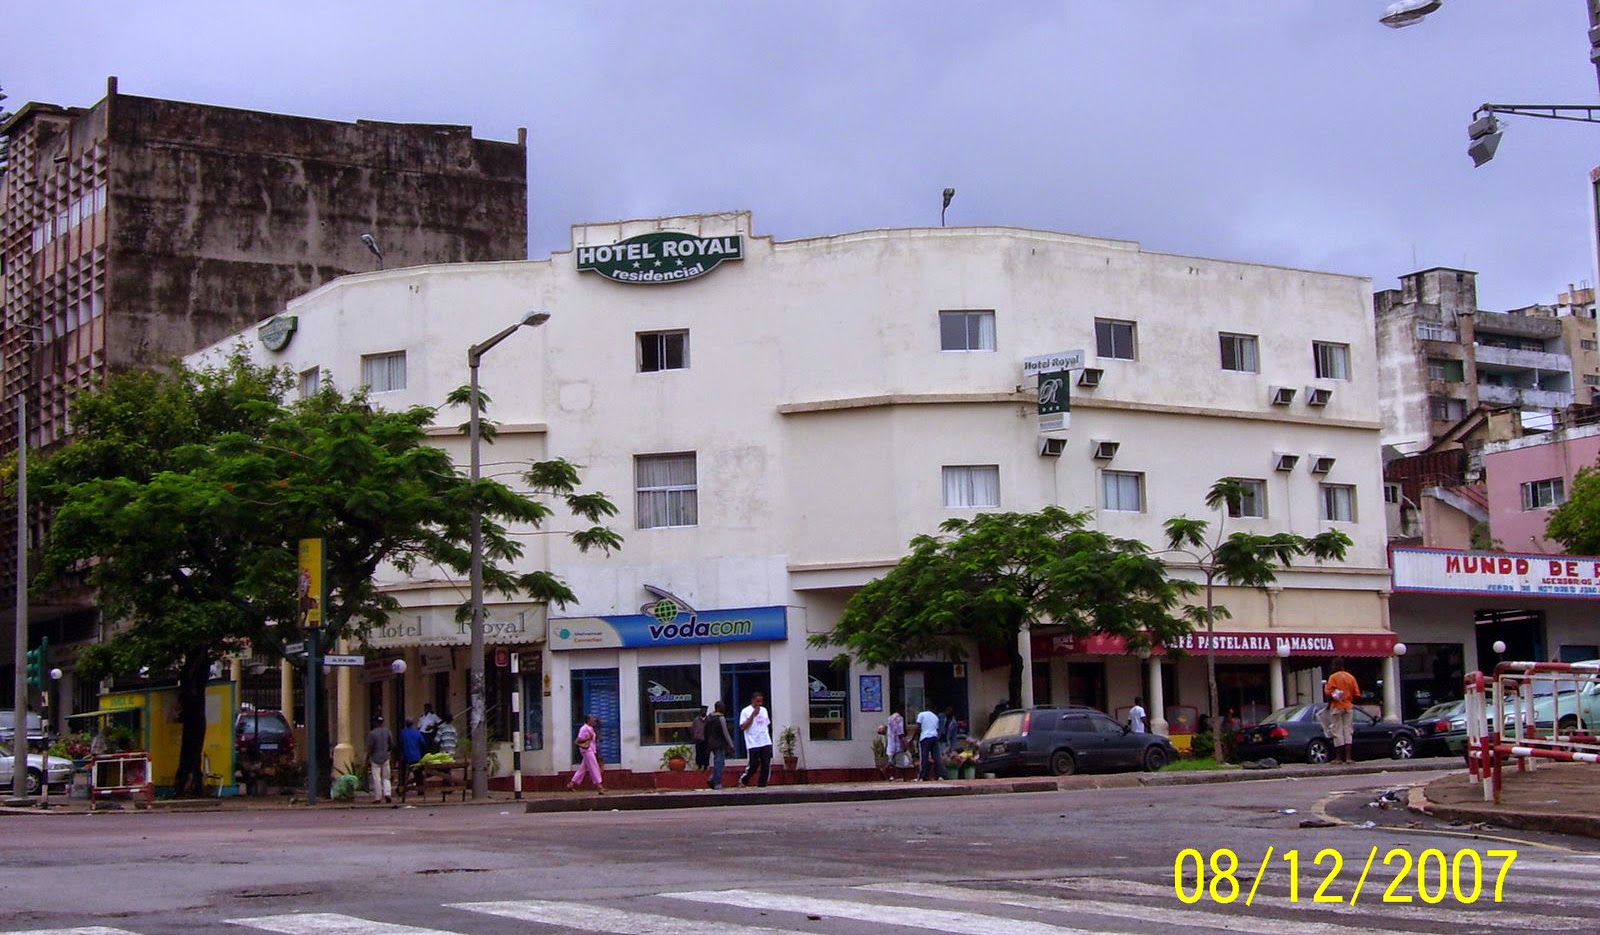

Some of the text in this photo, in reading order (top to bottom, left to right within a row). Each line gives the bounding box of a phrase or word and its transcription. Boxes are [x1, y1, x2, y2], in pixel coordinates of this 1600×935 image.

[579, 238, 738, 264] HOTEL ROYAL
[612, 262, 704, 282] residencial
[1024, 355, 1080, 370] Hotel Royal
[1446, 556, 1529, 576] MUNDO
[1550, 561, 1579, 577] DE
[650, 615, 752, 641] vodacom
[1276, 637, 1334, 650] DAMASCUA
